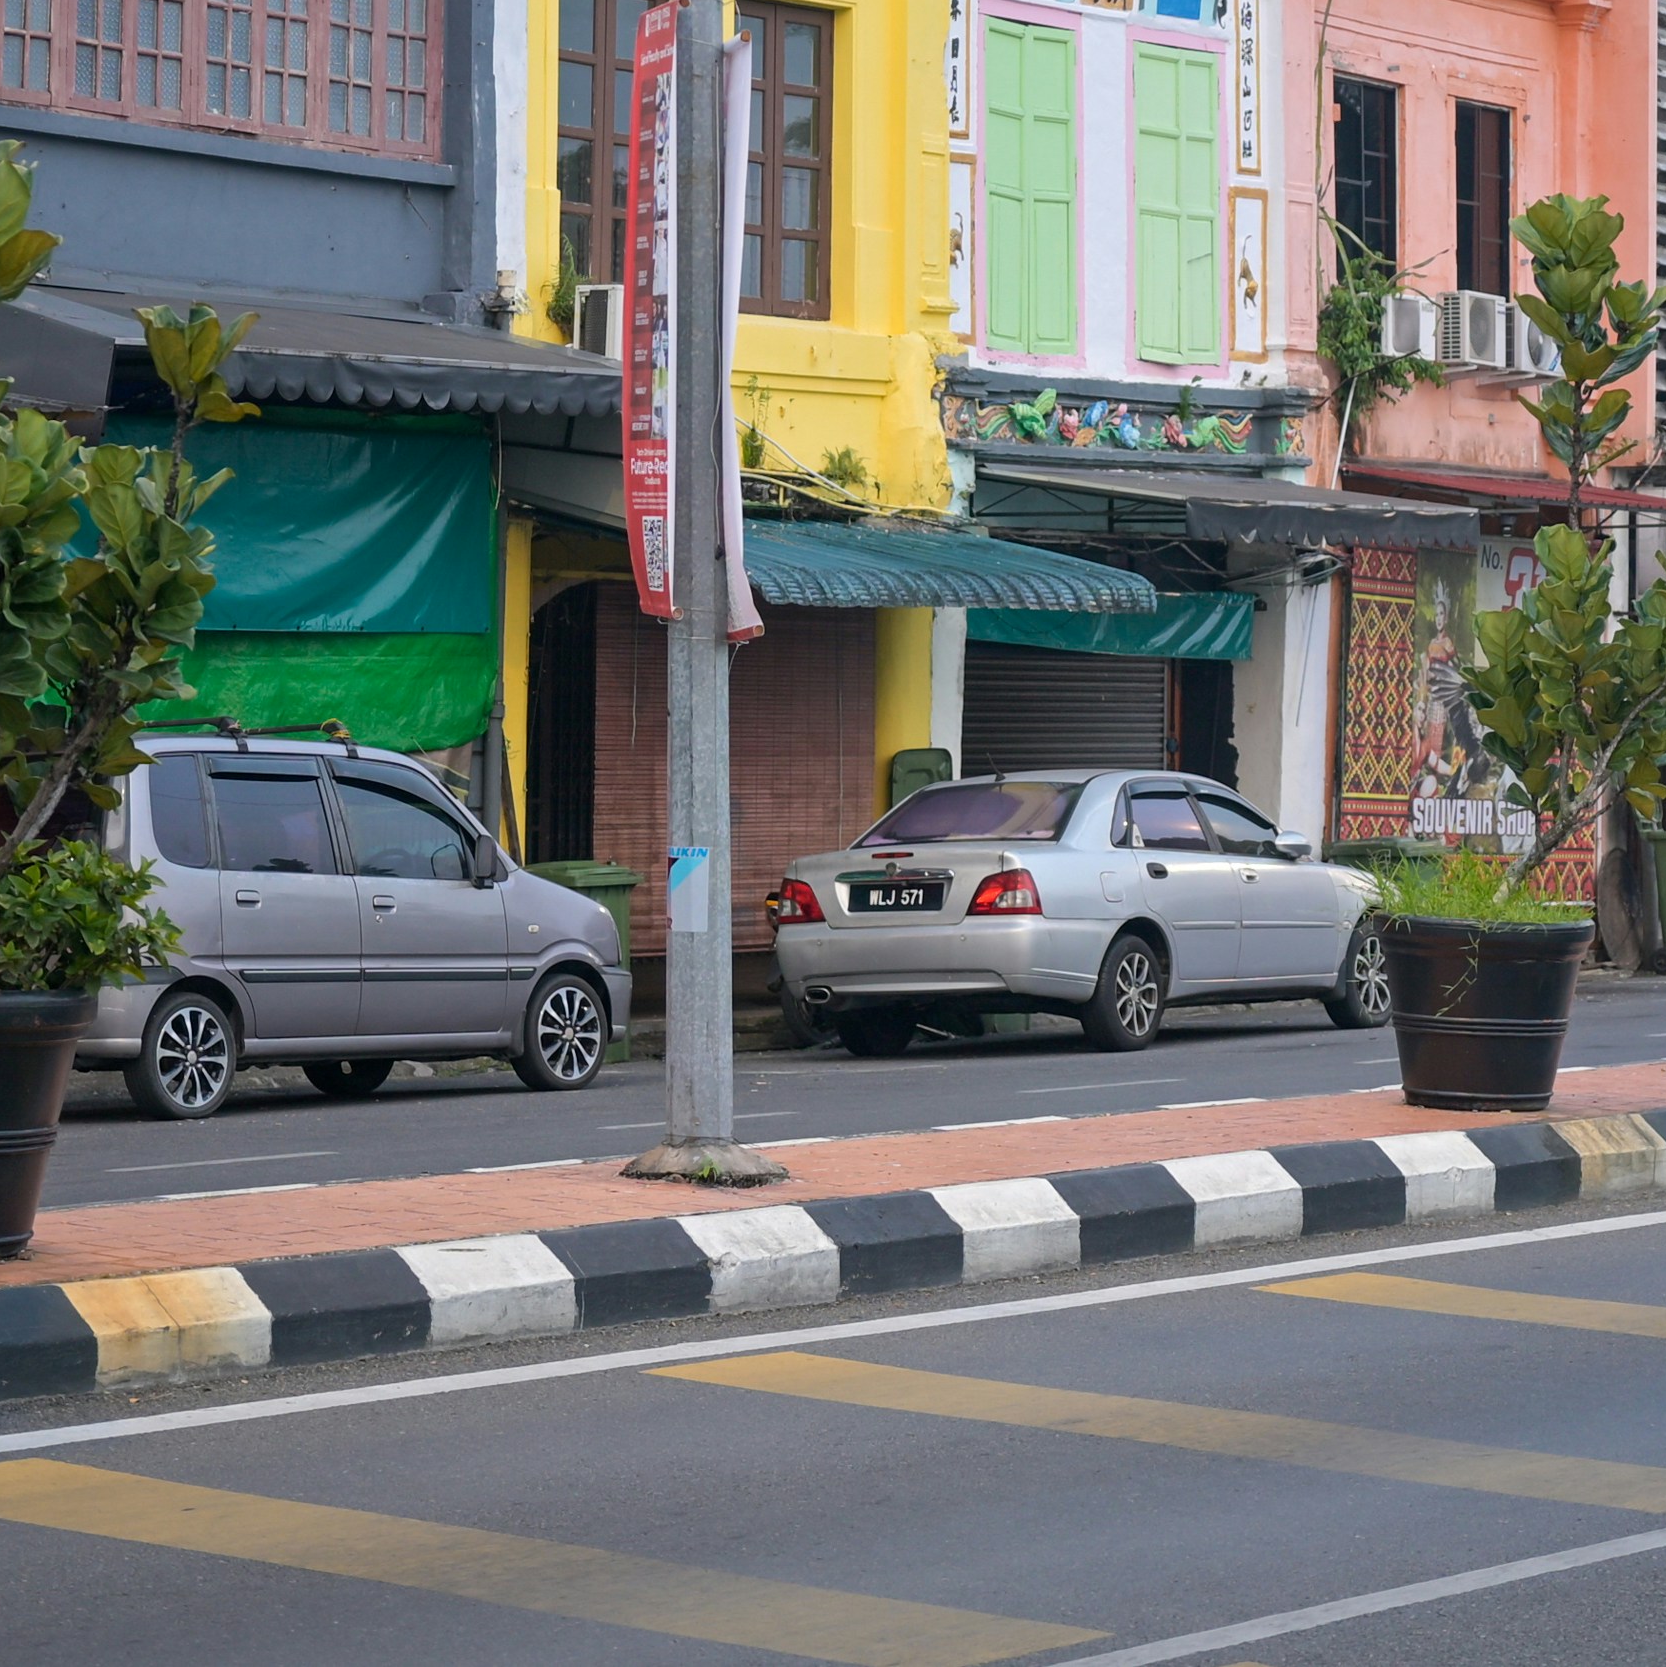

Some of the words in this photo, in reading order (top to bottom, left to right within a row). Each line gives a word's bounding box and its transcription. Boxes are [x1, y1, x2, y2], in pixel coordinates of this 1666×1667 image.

[1481, 544, 1503, 570] No.
[1412, 797, 1493, 834] SOUVENIR
[869, 890, 895, 906] WLJ
[900, 889, 923, 905] 571
